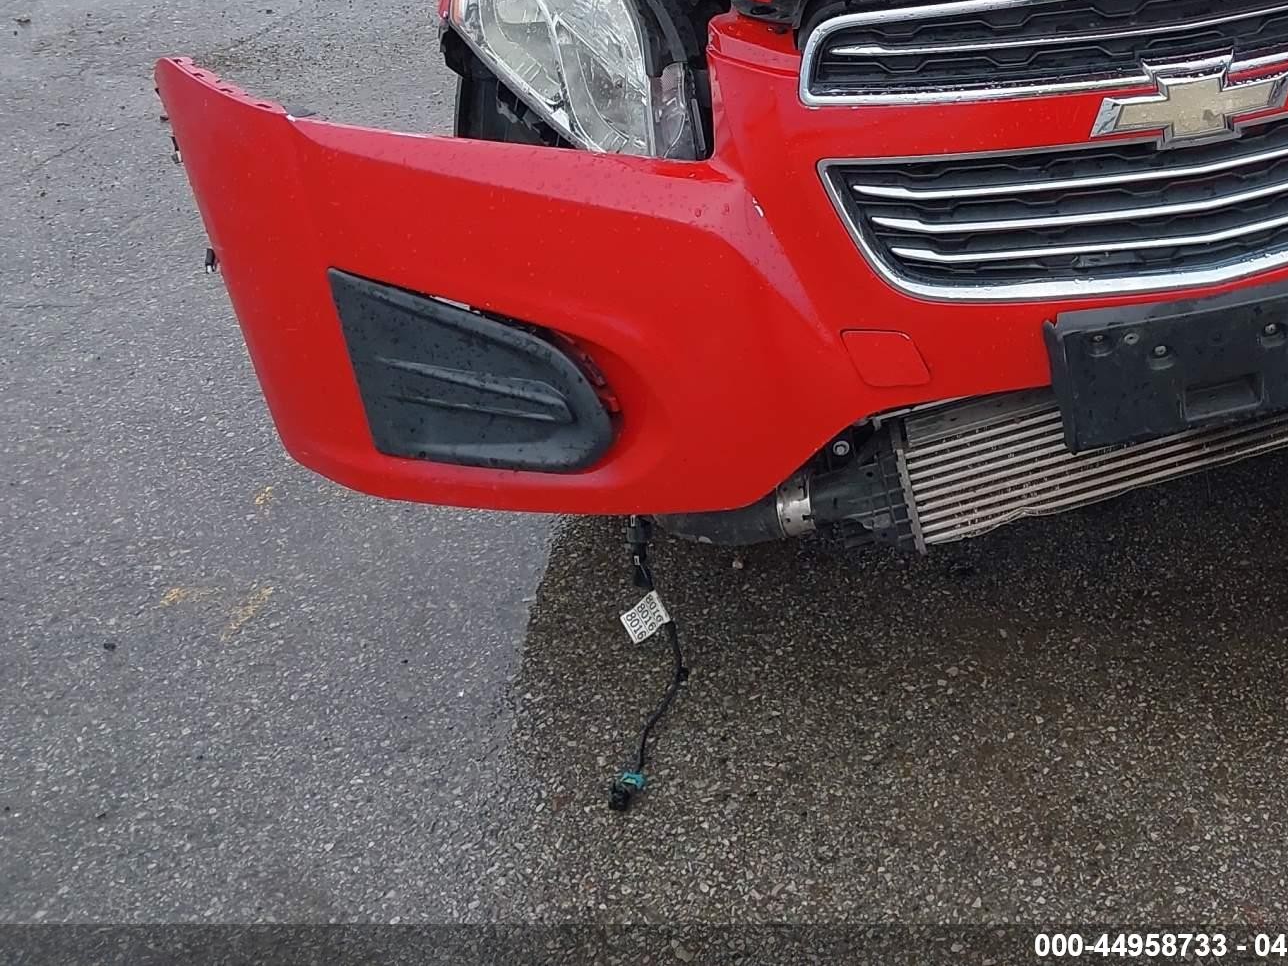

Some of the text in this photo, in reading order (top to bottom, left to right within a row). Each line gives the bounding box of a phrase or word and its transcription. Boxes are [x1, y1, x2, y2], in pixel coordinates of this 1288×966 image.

[637, 603, 657, 631] 8016
[645, 594, 664, 622] 8016
[626, 612, 647, 640] 8016
